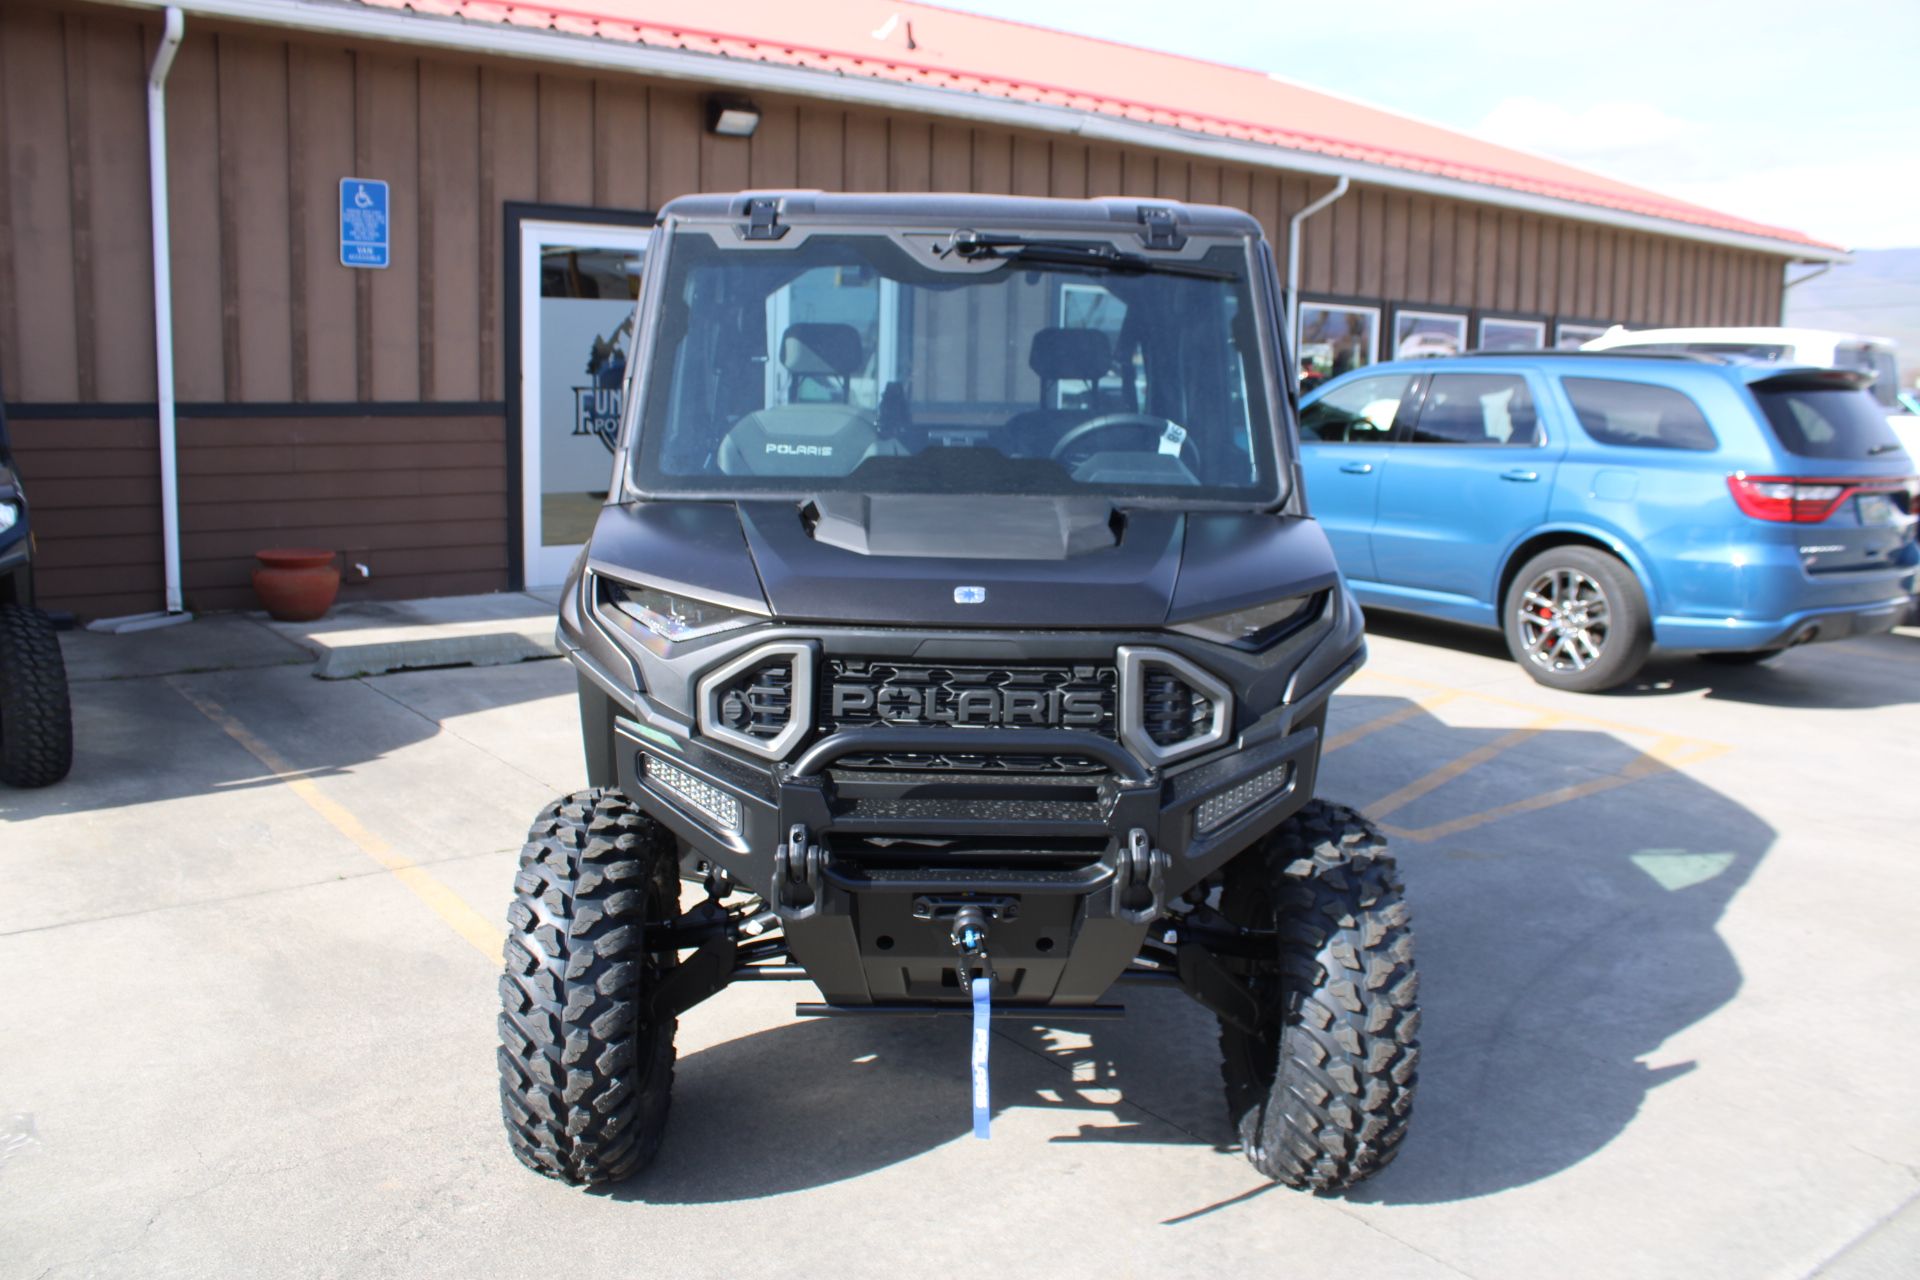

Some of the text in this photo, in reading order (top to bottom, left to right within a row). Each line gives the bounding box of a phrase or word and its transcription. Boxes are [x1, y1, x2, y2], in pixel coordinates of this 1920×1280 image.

[594, 418, 619, 433] PO
[766, 443, 833, 457] POLARIS
[832, 684, 1104, 725] POLARIS
[975, 1028, 987, 1109] POLARIS
